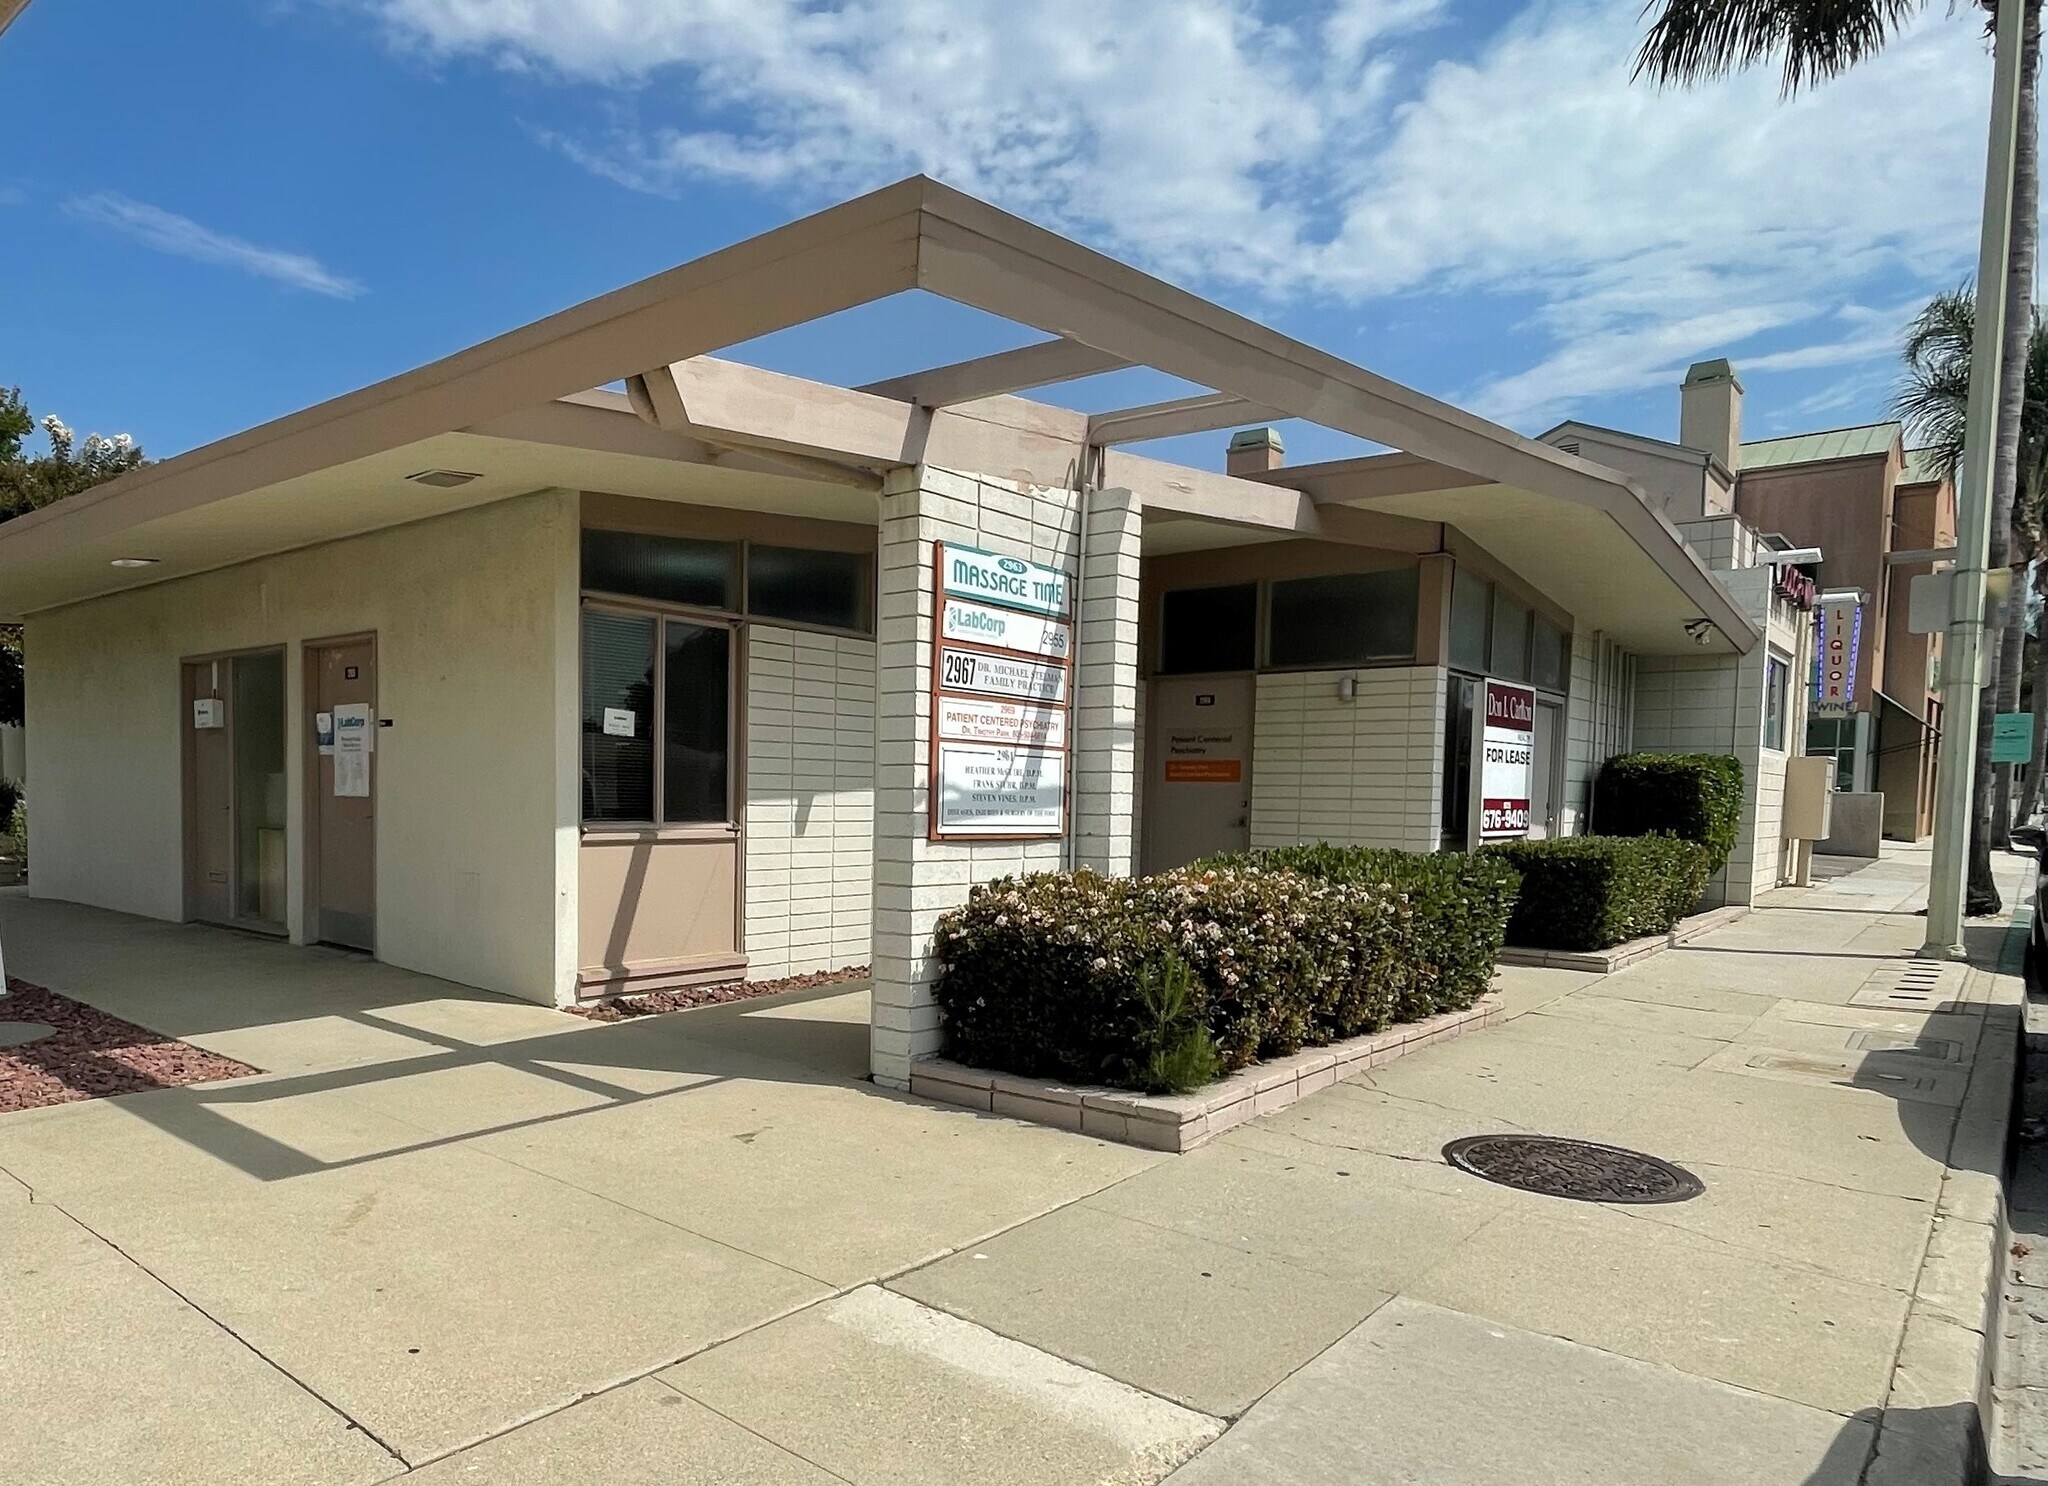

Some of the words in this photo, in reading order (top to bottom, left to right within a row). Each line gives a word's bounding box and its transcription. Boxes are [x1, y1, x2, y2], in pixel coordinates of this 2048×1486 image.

[1003, 560, 1023, 573] 2963
[953, 559, 1028, 597] MASSAGE
[1032, 581, 1063, 605] TIME
[957, 608, 1006, 637] LabCorp
[1042, 630, 1064, 648] 2955
[1829, 609, 1843, 697] LIQUOR
[945, 655, 976, 685] 2967
[977, 661, 992, 674] DR.
[994, 664, 1029, 679] MICHAEL
[984, 675, 1016, 688] FAMILY
[1017, 679, 1055, 695] PRACTICE
[1488, 693, 1502, 717] Don
[1817, 701, 1855, 712] WINE
[341, 717, 365, 728] LabCorp
[946, 711, 979, 724] PATIENT
[980, 715, 1018, 728] CENTERED
[1020, 718, 1059, 732] PSYCHIATRY
[1486, 747, 1504, 763] FOR
[1505, 750, 1531, 765] LEASE
[965, 766, 995, 776] HEATHER
[973, 779, 995, 788] FRANK
[971, 793, 996, 803] STEVEN
[1483, 808, 1529, 830] 676-9409
